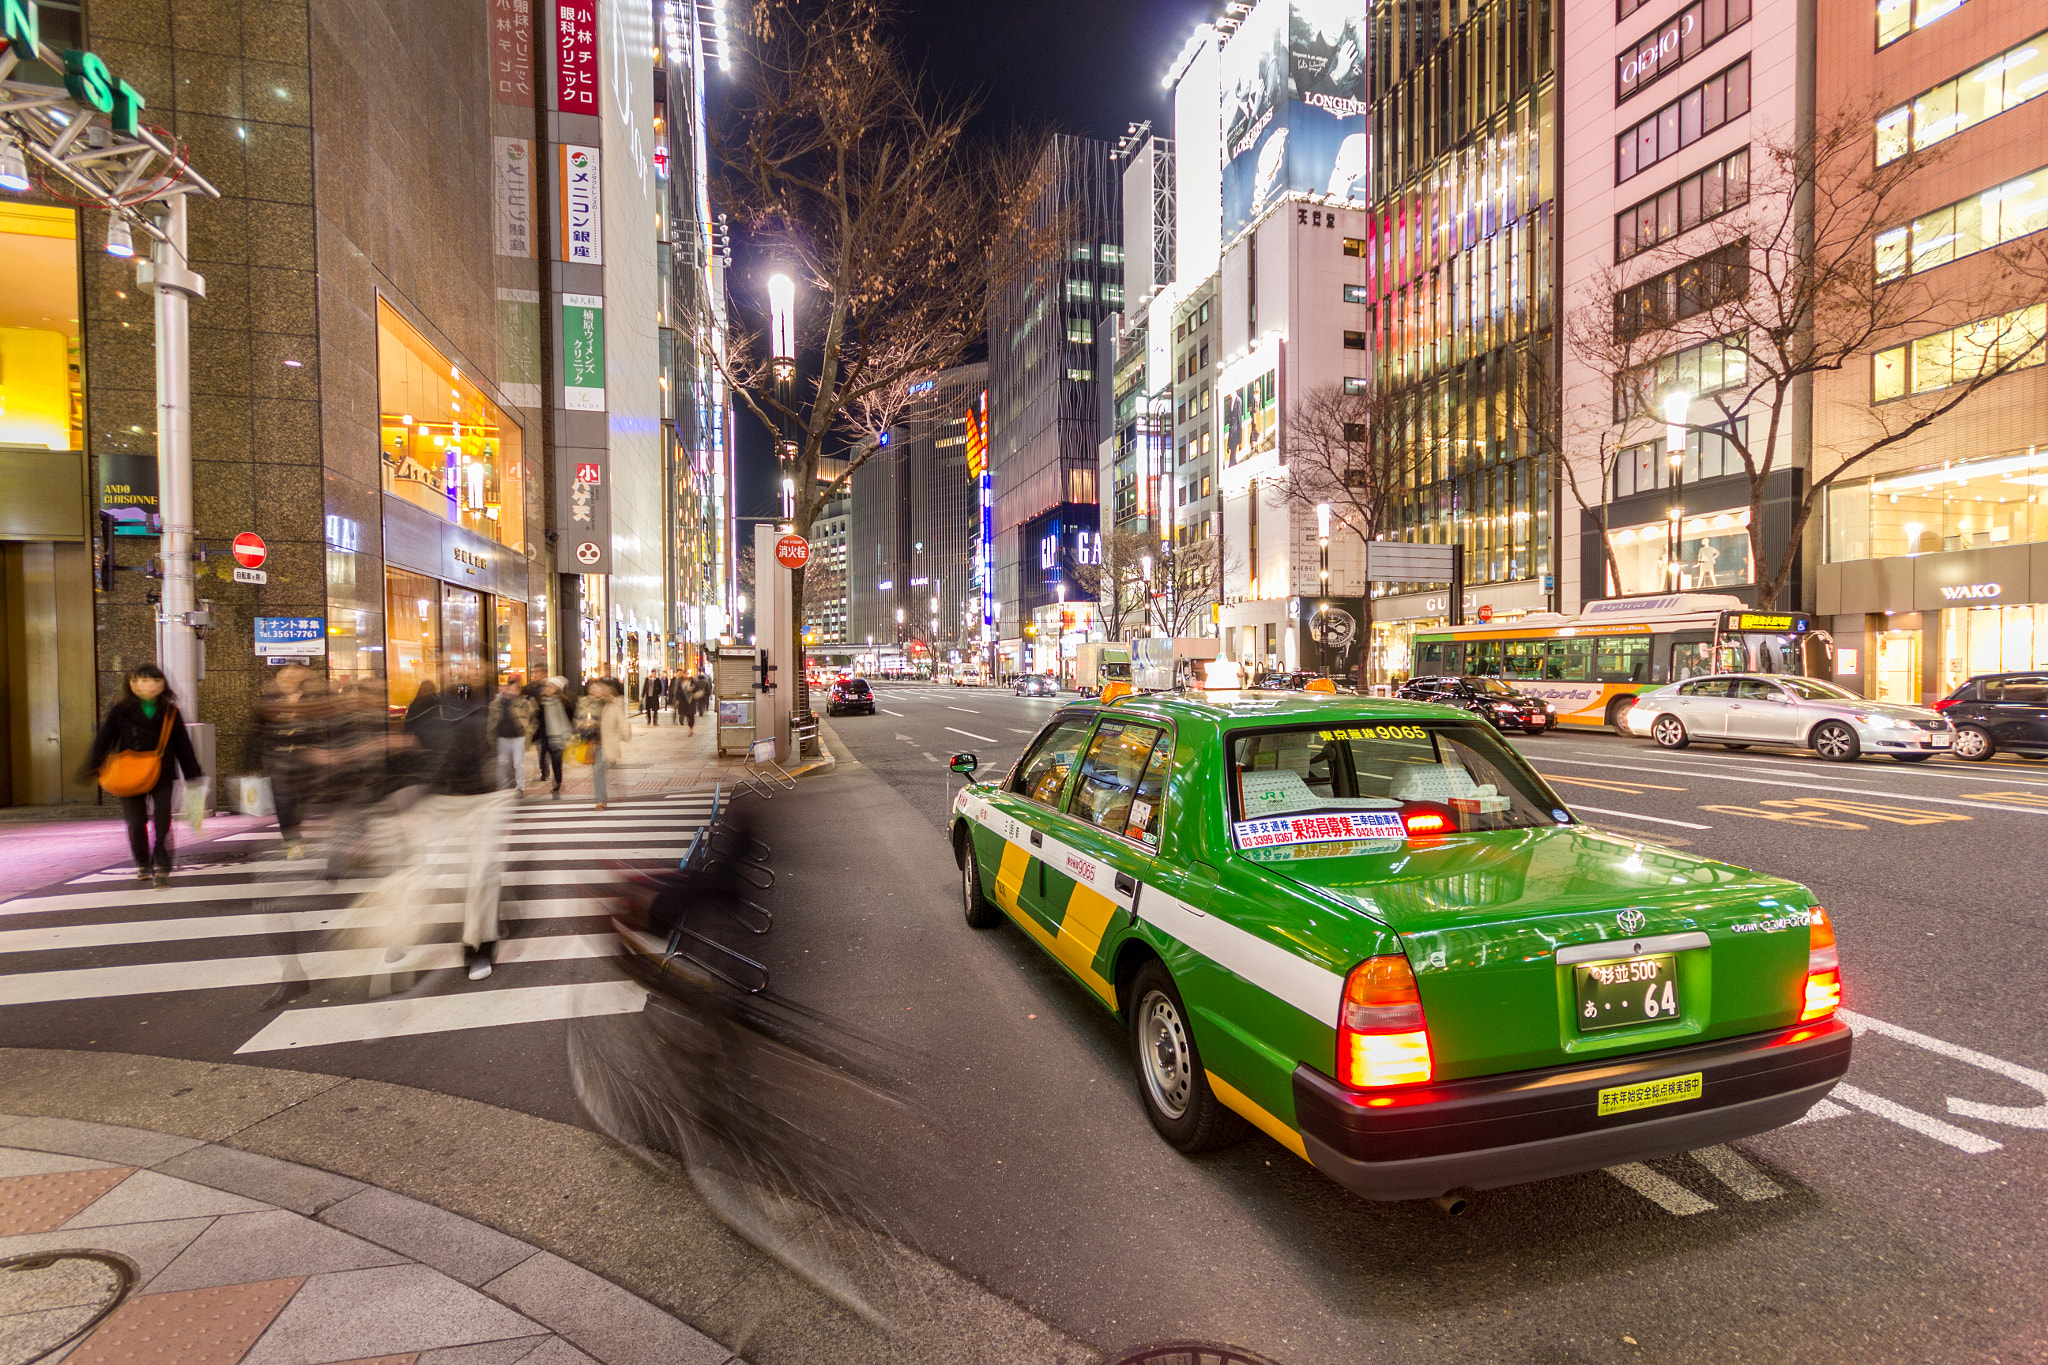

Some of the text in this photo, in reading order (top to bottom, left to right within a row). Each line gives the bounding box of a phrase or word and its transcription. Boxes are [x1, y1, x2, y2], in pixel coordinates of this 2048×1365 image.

[560, 6, 577, 101] 眼科クリニック
[577, 9, 592, 104] 小林チヒロ
[1304, 91, 1366, 114] LONGINE
[572, 172, 591, 258] メニコン銀座
[573, 339, 584, 385] クリニック
[579, 465, 598, 481] 小
[104, 484, 131, 494] ANDO
[104, 494, 158, 506] CLOISONNE
[778, 545, 806, 558] 消火栓
[1041, 535, 1056, 570] GAP
[1078, 532, 1102, 565] GA
[1940, 583, 2002, 600] WAKO
[1426, 594, 1477, 612] GUCI
[1601, 600, 1648, 612] Hybrid
[258, 619, 320, 630] テナント募集
[1627, 624, 1646, 632] Bus
[272, 630, 317, 638] 3561-7761
[1521, 687, 1592, 700] Hybrid
[1260, 791, 1276, 800] JR
[1238, 819, 1291, 836] 三幸交通株
[1291, 816, 1356, 840] 乗務員募集
[1352, 814, 1400, 827] 三幸自動車株
[1241, 832, 1294, 847] 03-3399-8367
[1356, 827, 1404, 838] 0424-61-2775
[1584, 980, 1677, 1018] あ 64
[1602, 1078, 1699, 1108] 年末年始安全総点検実施中
